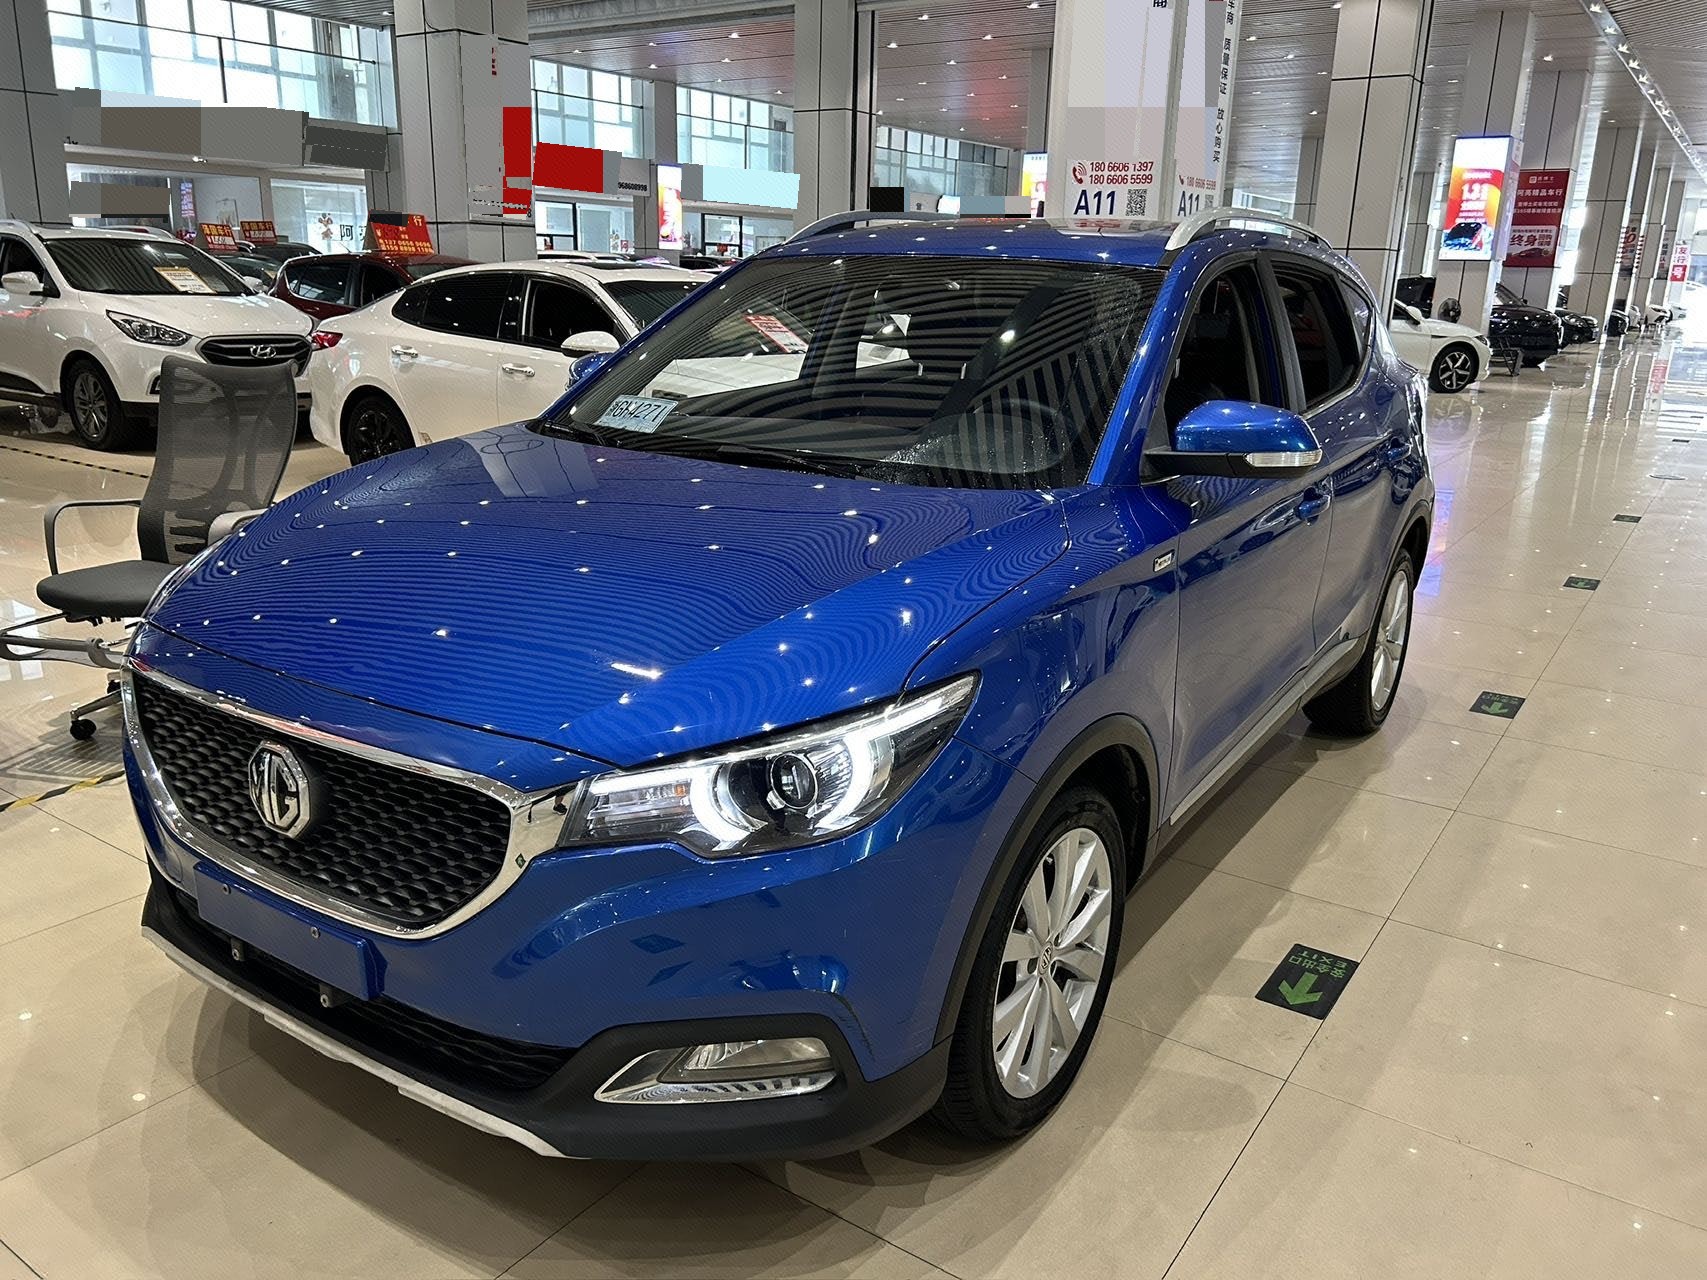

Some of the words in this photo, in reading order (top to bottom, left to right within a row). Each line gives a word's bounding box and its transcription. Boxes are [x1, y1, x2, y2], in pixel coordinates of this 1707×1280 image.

[1089, 161, 1106, 172] 180
[1107, 161, 1130, 172] 6606
[1132, 161, 1154, 172] 1397
[1088, 174, 1105, 185] 180
[1106, 174, 1129, 185] 6606
[1129, 174, 1153, 184] 5599
[1073, 189, 1117, 216] A11
[1177, 190, 1200, 217] A11
[1509, 233, 1538, 247] 终身
[251, 752, 298, 828] MG
[1288, 956, 1346, 978] 安全出口
[1299, 951, 1348, 968] EXIT
